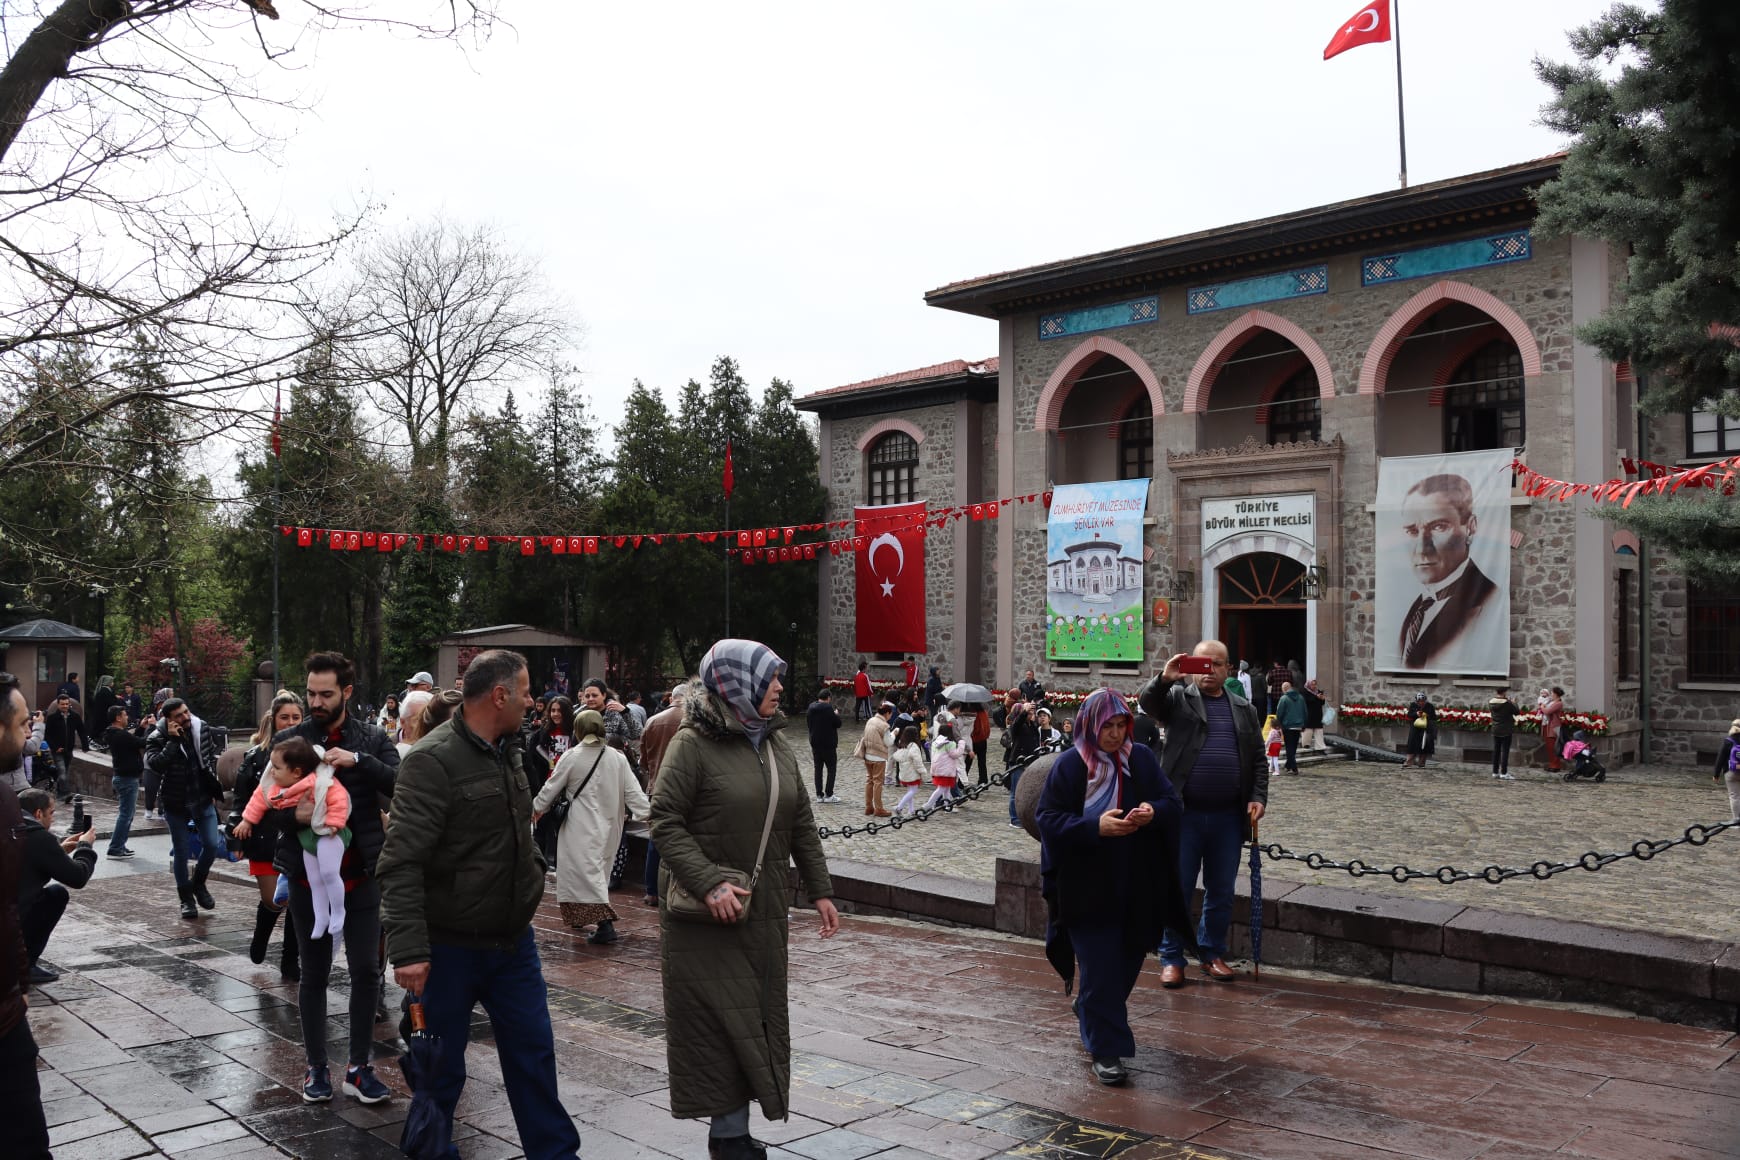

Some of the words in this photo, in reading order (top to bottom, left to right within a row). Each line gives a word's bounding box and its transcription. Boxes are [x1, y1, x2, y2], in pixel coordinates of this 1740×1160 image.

[1235, 500, 1279, 513] TÜRKİYE
[1101, 516, 1114, 528] VAR
[1205, 516, 1235, 530] BÜYÜK
[1239, 515, 1271, 528] MİLLET
[1273, 512, 1312, 526] MECLİSİ
